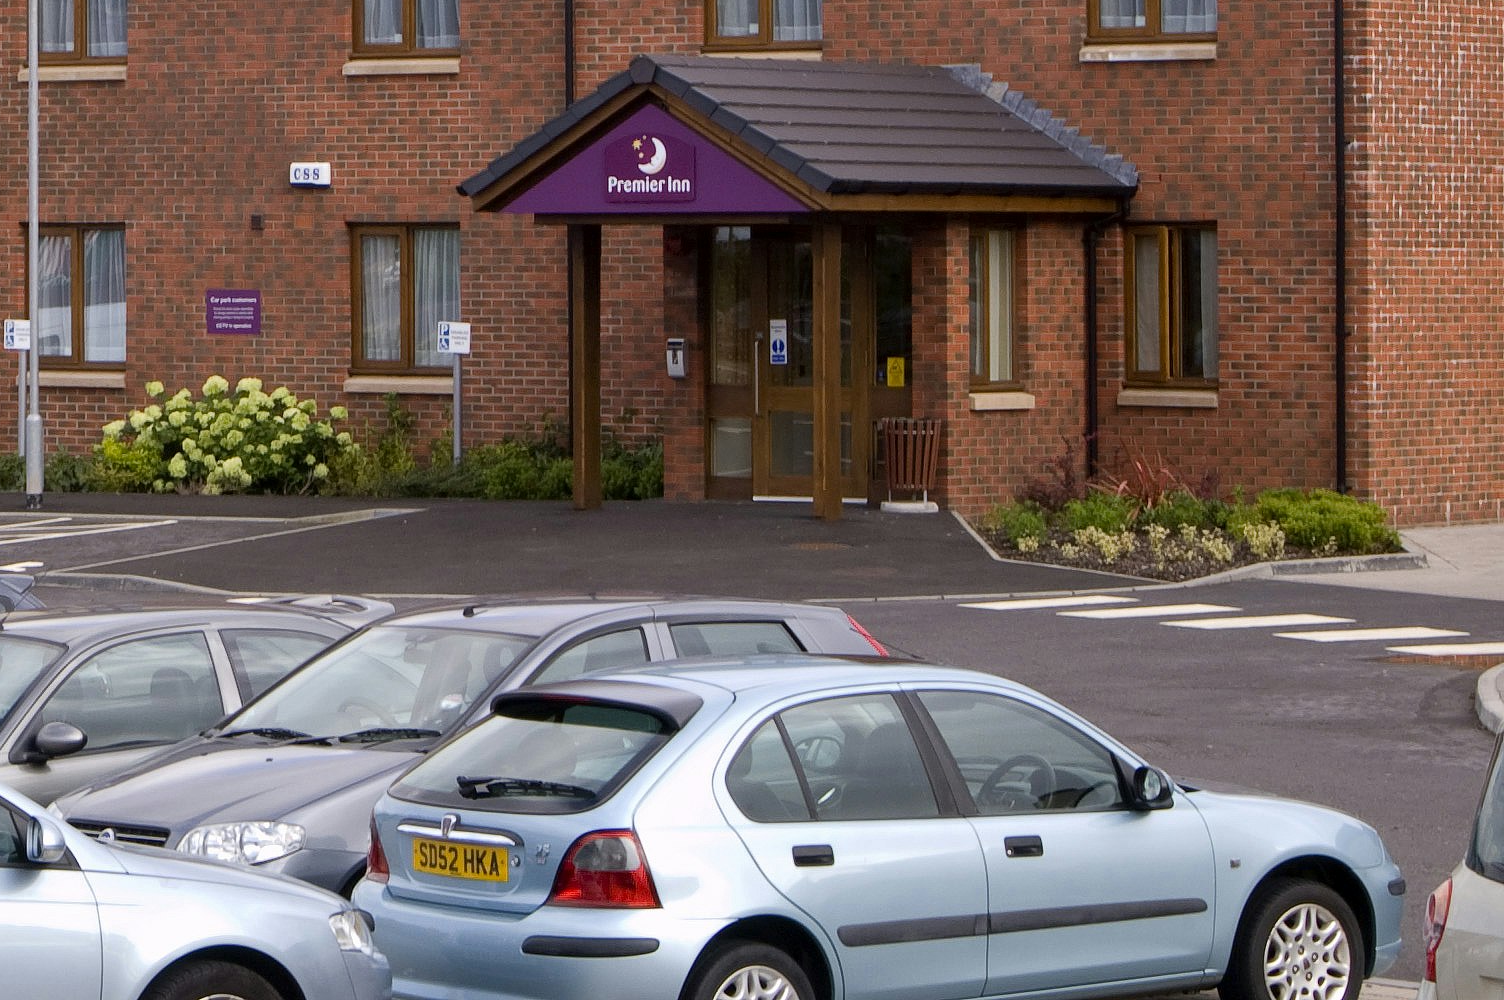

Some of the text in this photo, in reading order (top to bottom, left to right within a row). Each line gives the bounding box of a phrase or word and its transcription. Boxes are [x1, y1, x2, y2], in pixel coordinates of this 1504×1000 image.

[293, 167, 320, 180] CSS
[607, 175, 691, 193] Premier Inn
[419, 841, 501, 877] SD52 HKA
